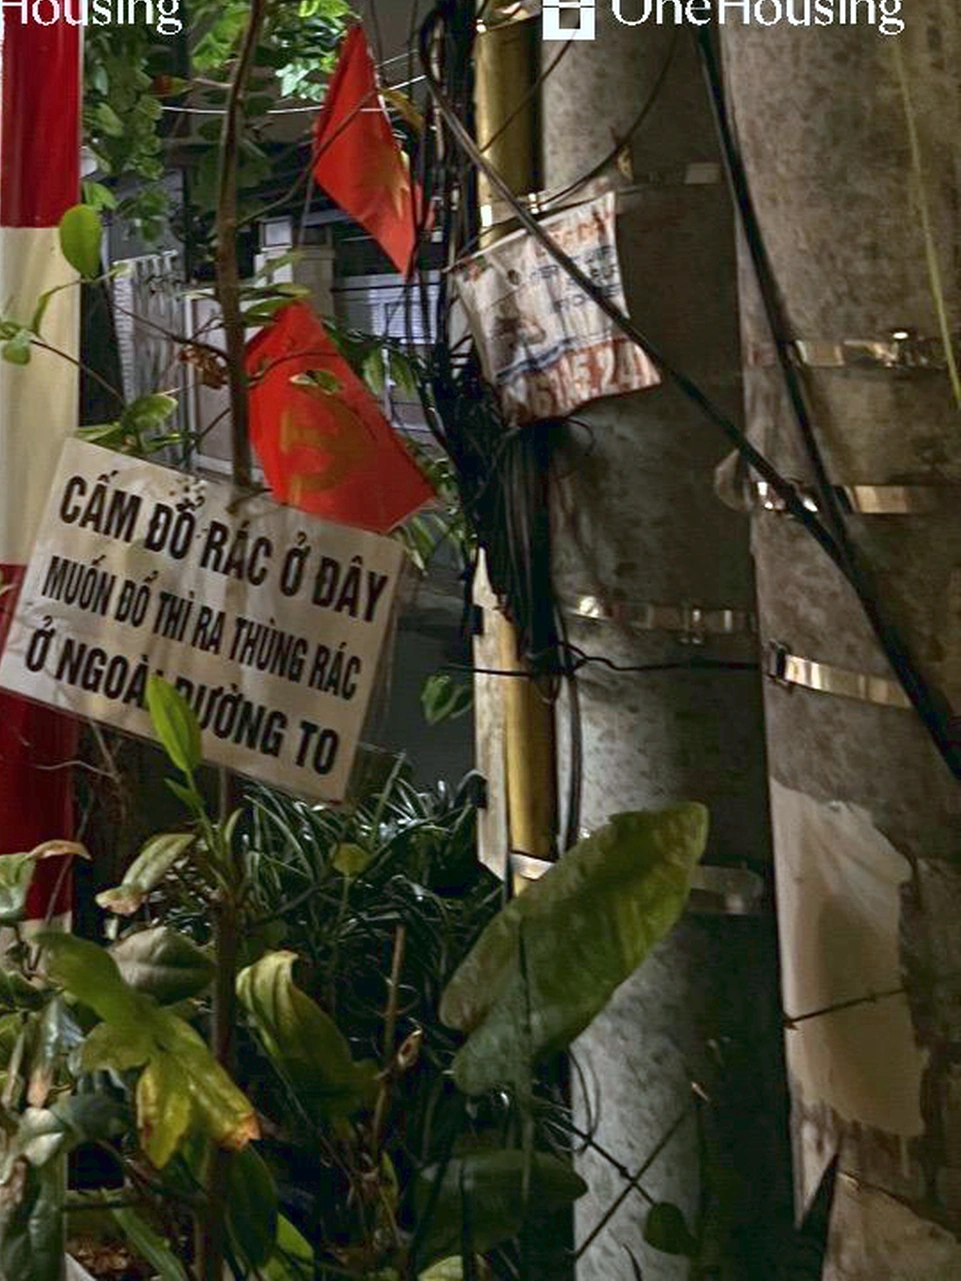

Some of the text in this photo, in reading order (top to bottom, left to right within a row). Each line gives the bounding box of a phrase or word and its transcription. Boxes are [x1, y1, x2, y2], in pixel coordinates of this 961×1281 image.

[60, 470, 388, 622] CẤM ĐỔ RÁC Ở ĐÂY
[25, 615, 54, 673] Ở
[55, 637, 164, 712] NGOÀ
[294, 719, 340, 776] TO
[41, 554, 117, 617] MUỐN
[152, 590, 195, 642] THÌ
[191, 604, 227, 655] RA
[229, 617, 308, 683] THÙNG
[308, 641, 362, 701] RÁC
